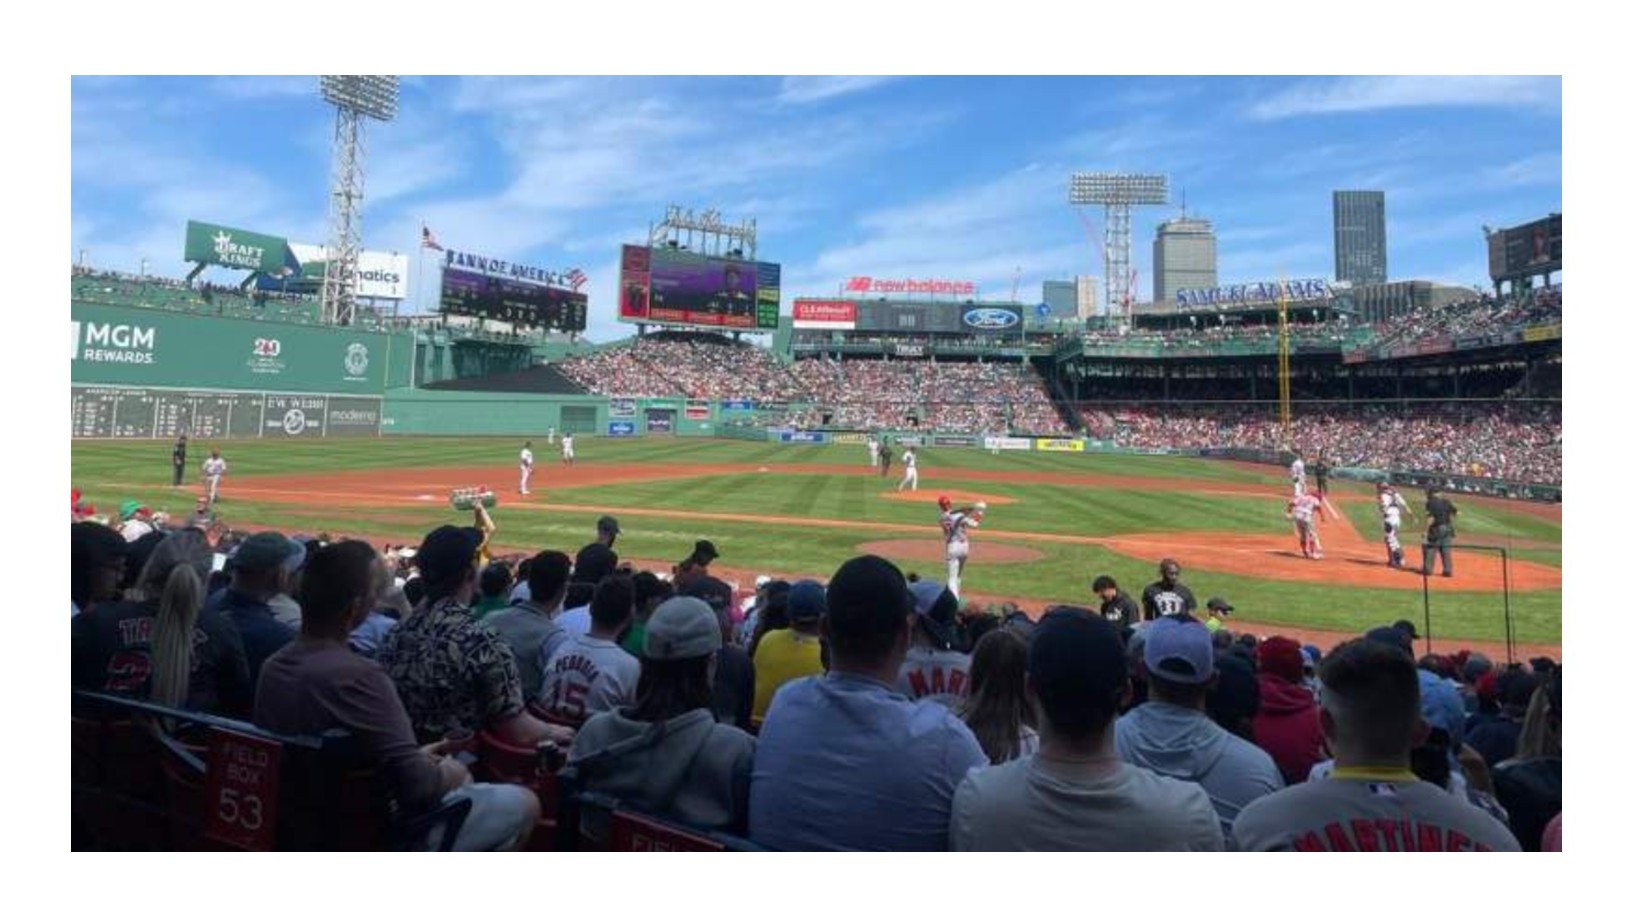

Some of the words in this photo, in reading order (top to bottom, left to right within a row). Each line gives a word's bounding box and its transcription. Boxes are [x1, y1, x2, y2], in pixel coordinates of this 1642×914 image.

[489, 259, 507, 273] OF
[511, 264, 564, 285] AMERICA
[1176, 285, 1250, 306] SAMUEL
[1256, 279, 1325, 300] ADAMS
[86, 321, 155, 349] MGM
[84, 348, 154, 364] REWARDS
[907, 665, 971, 699] MAR
[551, 678, 590, 716] 15
[223, 741, 268, 768] FIELD
[227, 762, 260, 783] BOX
[220, 787, 262, 829] 53
[1294, 813, 1497, 851] MARTINE
